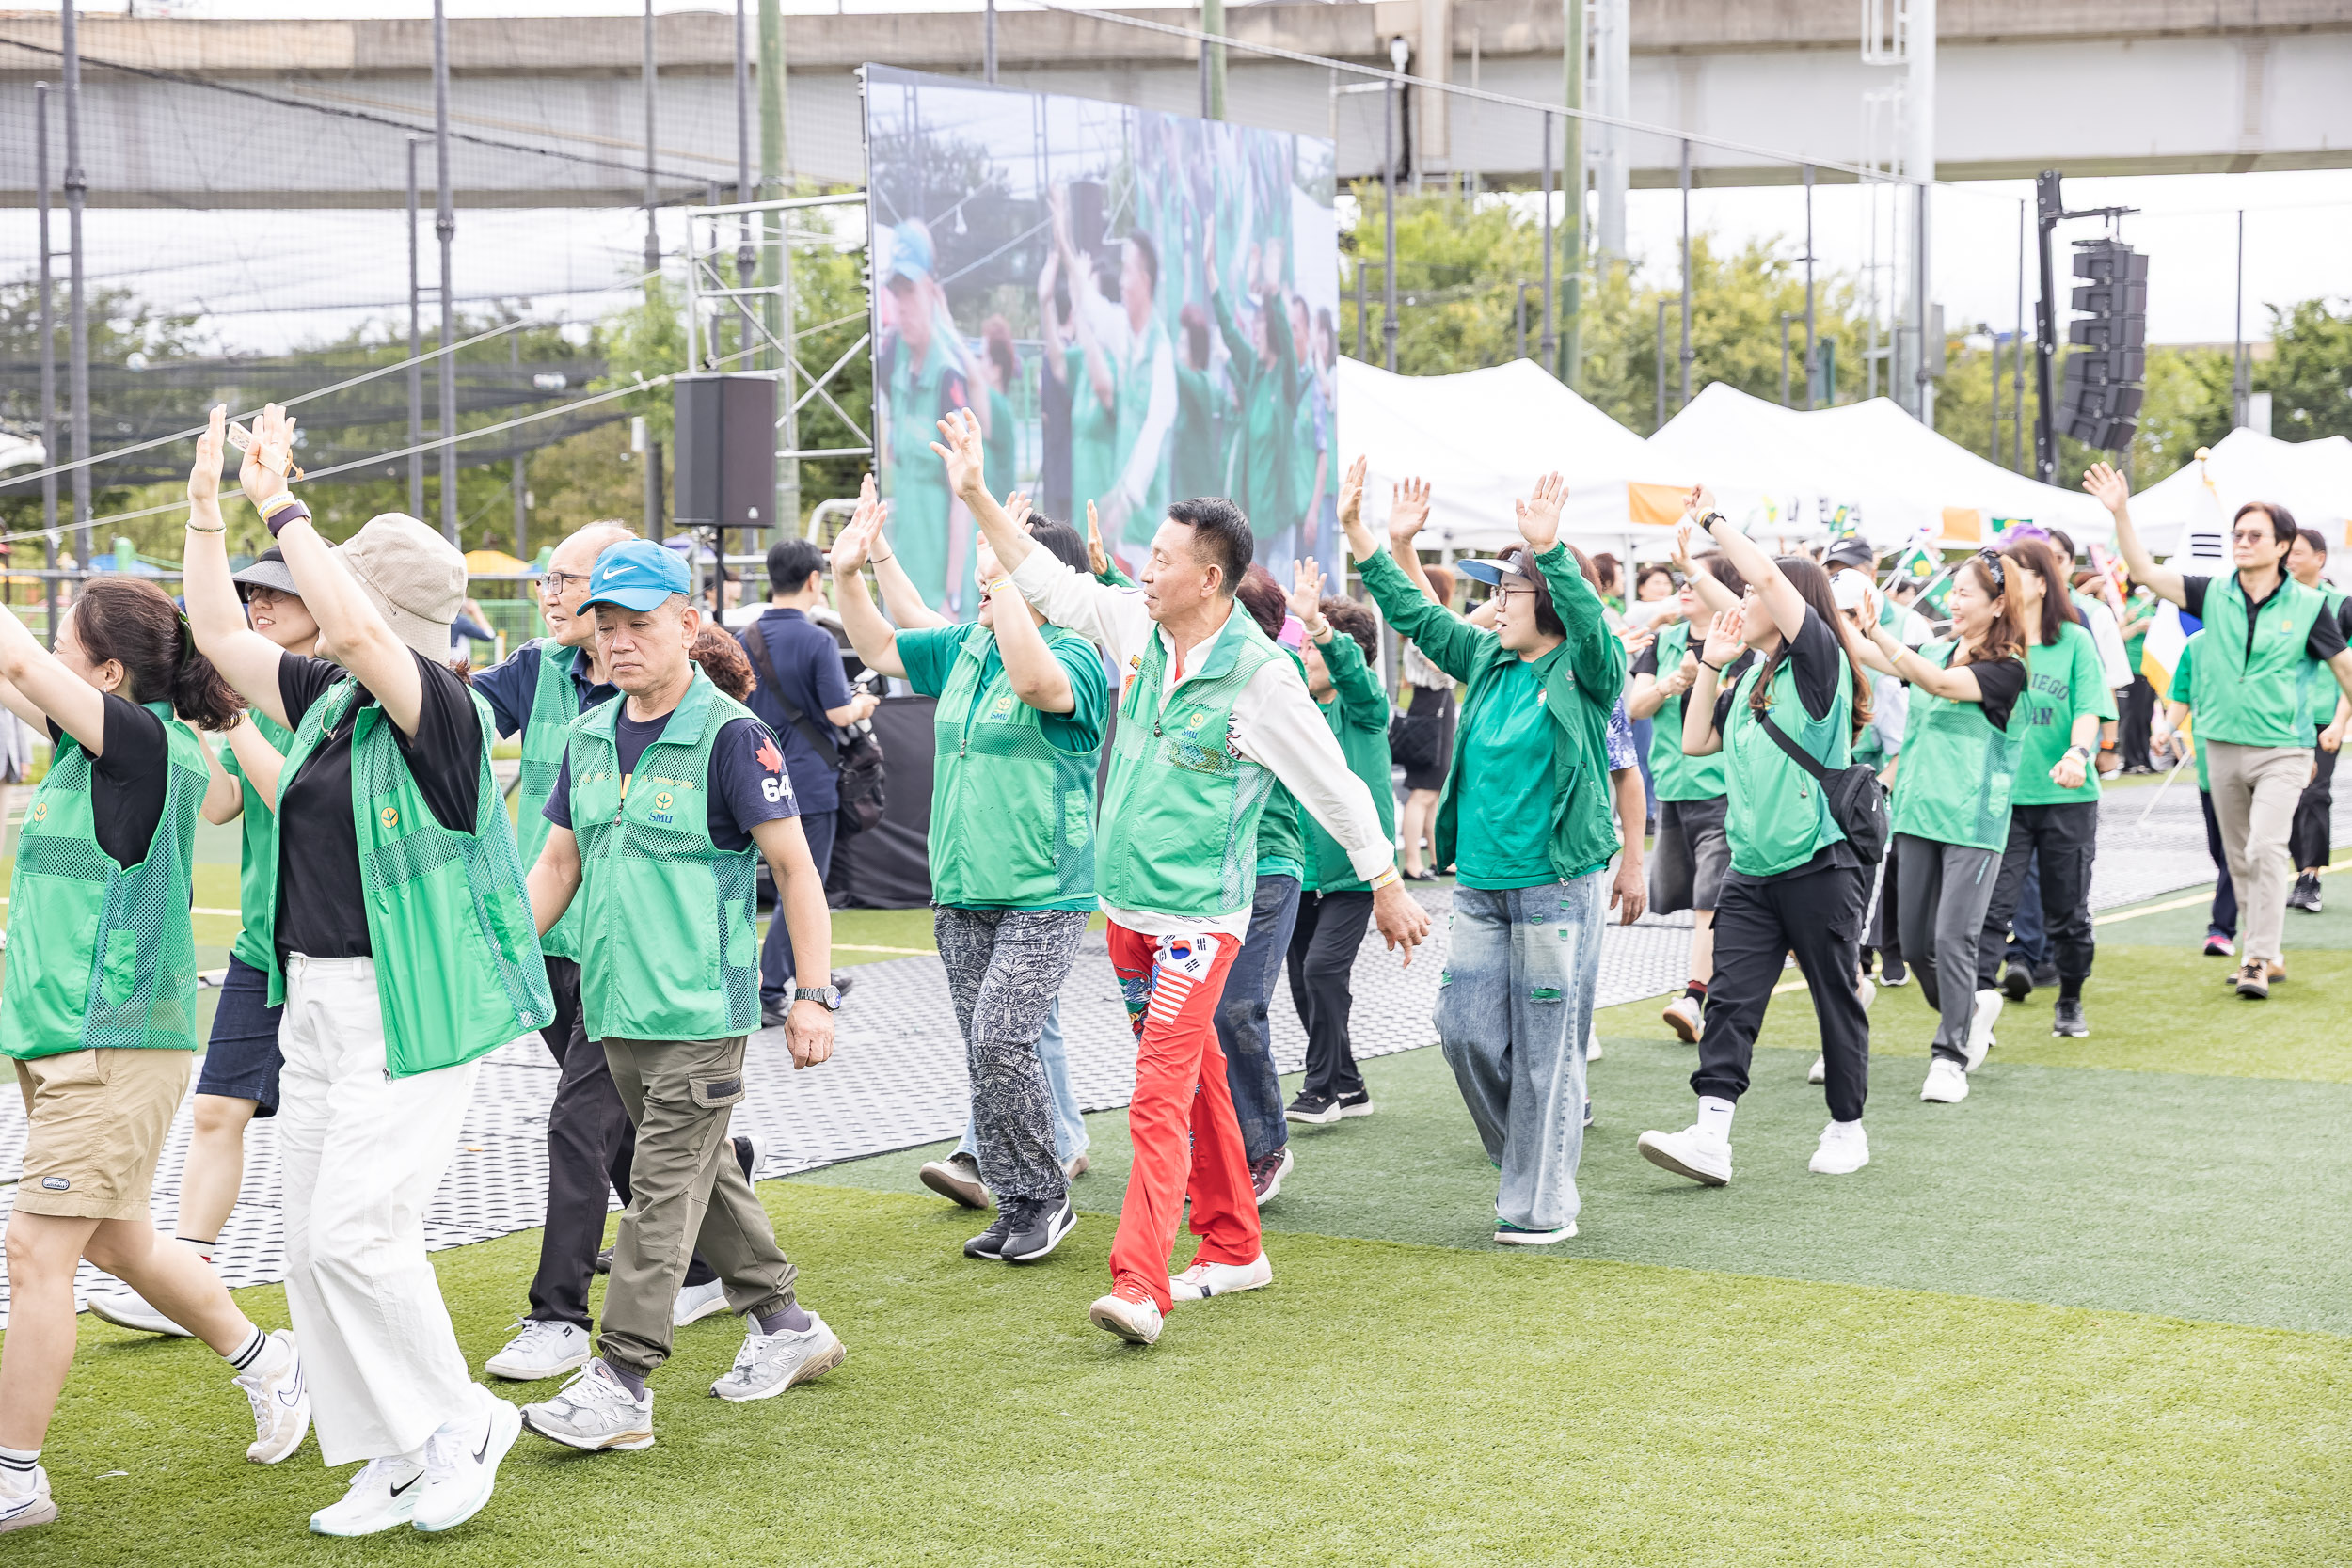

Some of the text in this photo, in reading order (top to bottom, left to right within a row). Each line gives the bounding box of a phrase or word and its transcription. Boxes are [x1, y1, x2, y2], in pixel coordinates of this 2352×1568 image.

[991, 711, 1009, 721] SMU
[760, 774, 795, 803] 64
[648, 812, 674, 824] SMU
